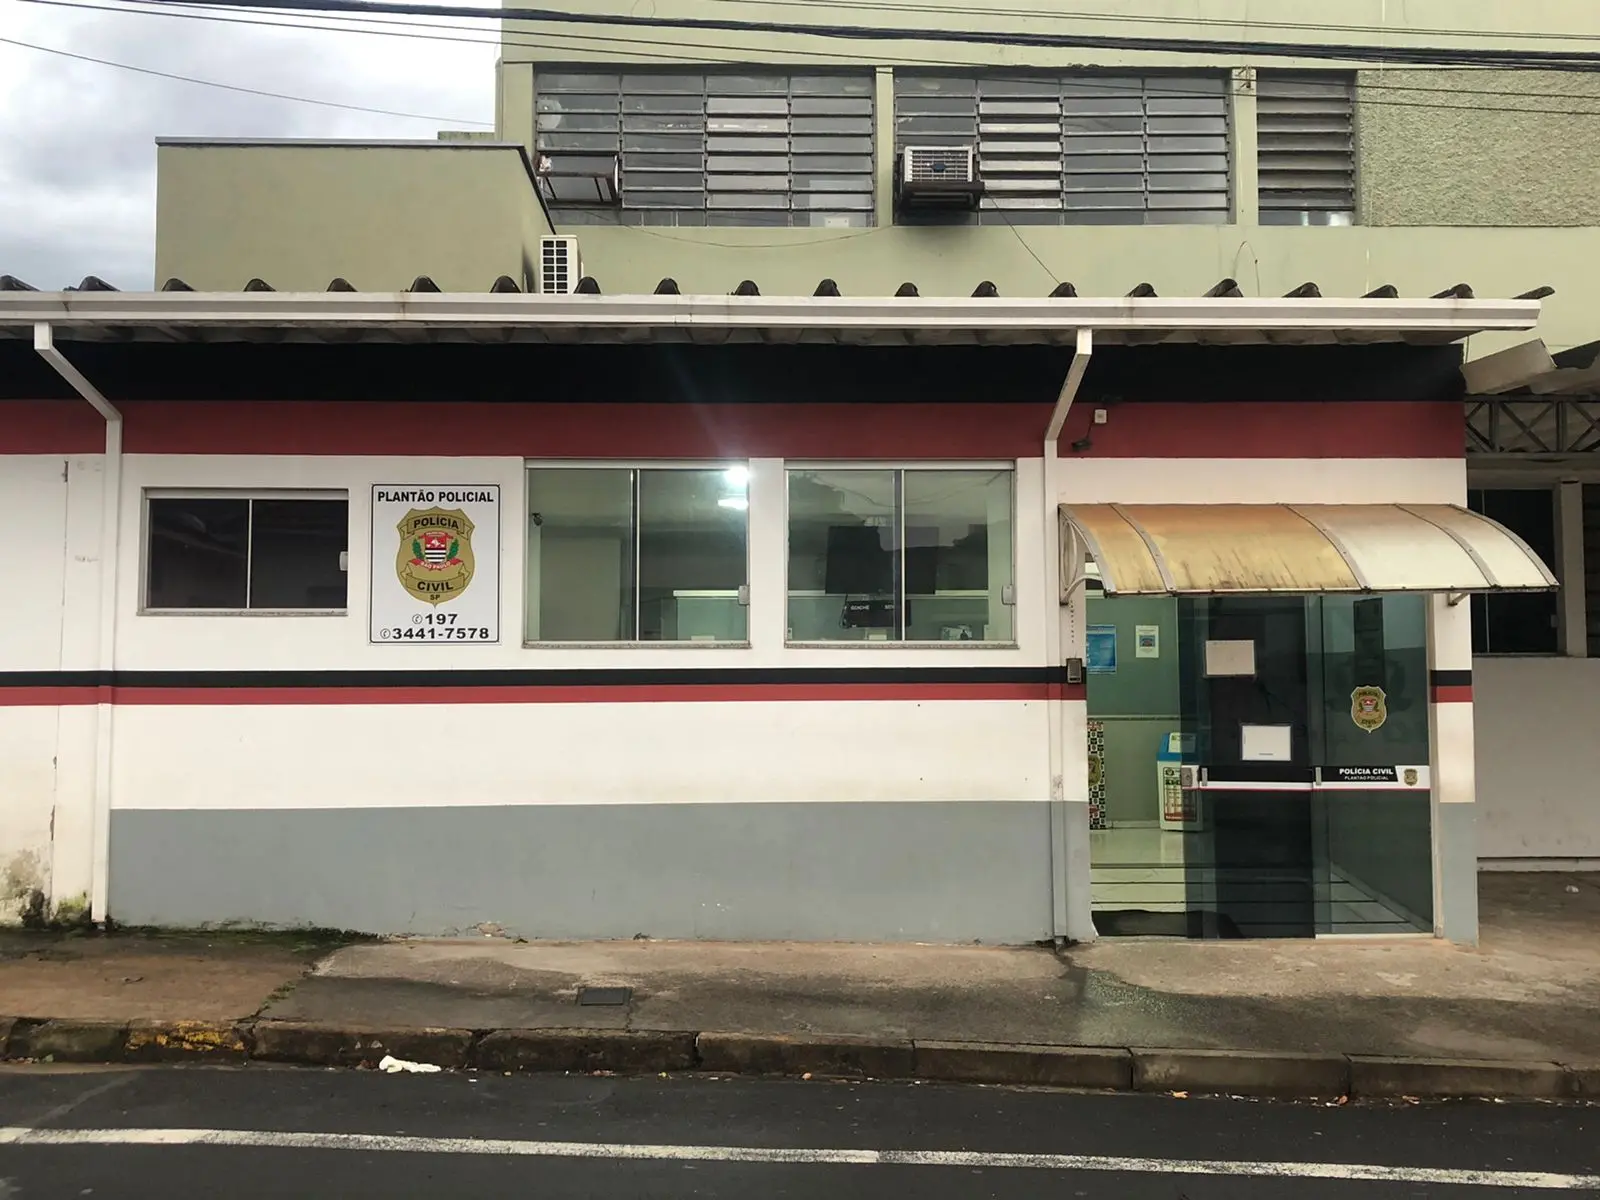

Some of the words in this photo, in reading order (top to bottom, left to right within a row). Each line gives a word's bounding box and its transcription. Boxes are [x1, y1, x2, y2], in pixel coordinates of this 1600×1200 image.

[377, 489, 434, 502] PLANTÃO
[438, 491, 494, 502] POLICIAL
[414, 515, 459, 529] POLÍCIA
[417, 581, 454, 591] CIVIL
[425, 613, 458, 625] 197
[392, 628, 489, 639] 3441-7578
